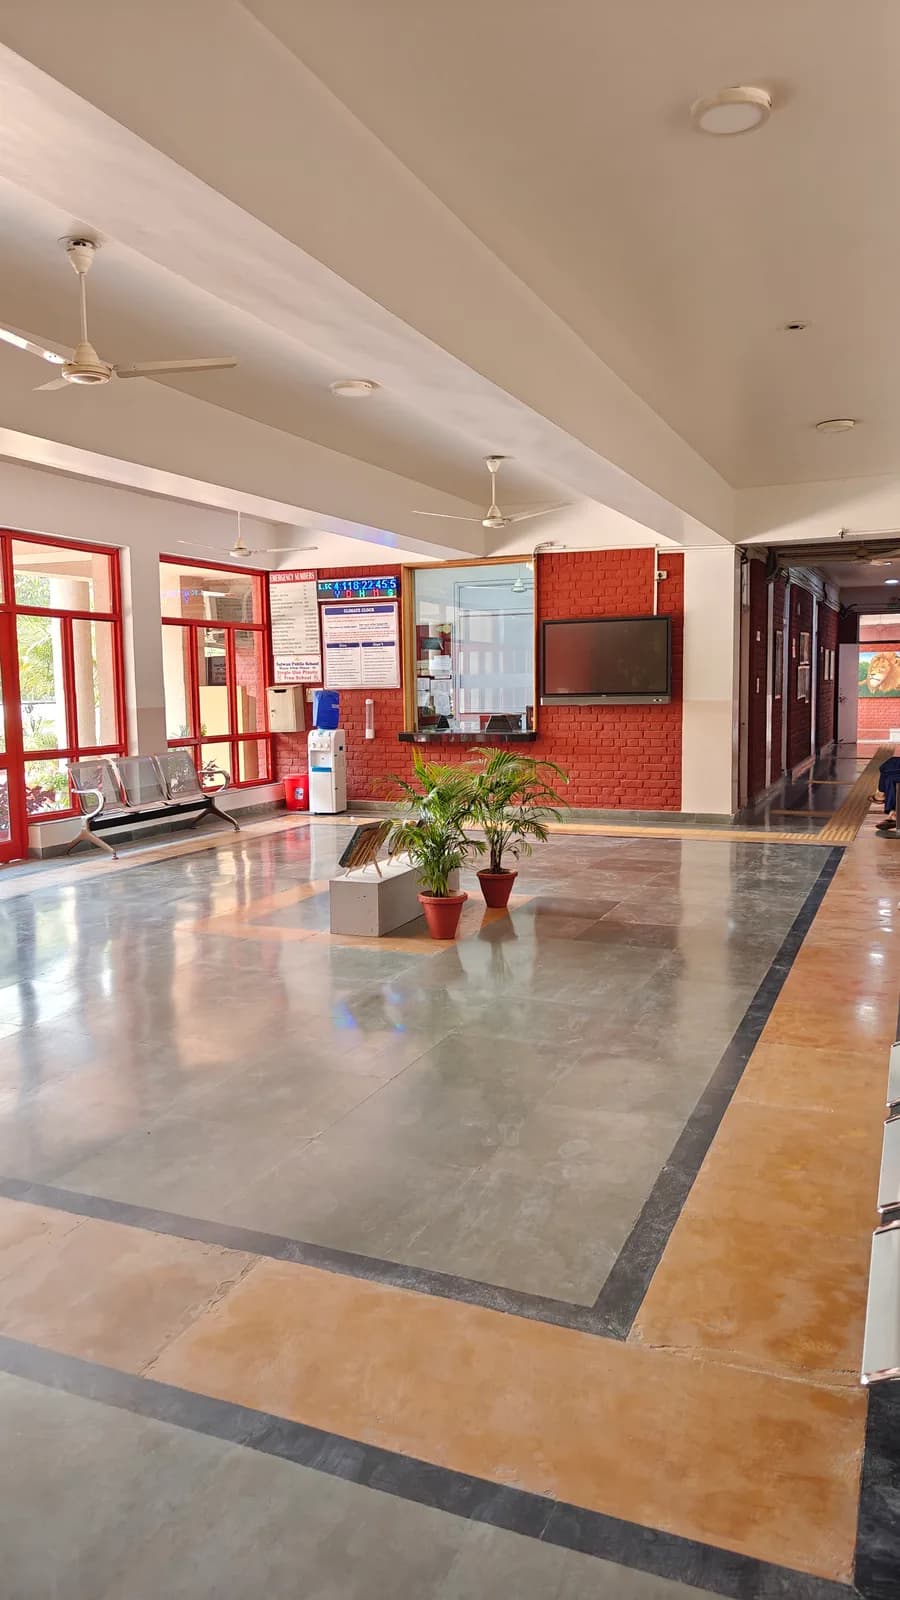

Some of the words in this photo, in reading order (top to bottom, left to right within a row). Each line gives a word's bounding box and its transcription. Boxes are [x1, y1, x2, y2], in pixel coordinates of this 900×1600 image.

[270, 574, 293, 583] EMERGENCY
[294, 572, 315, 581] NUMBERS
[334, 590, 341, 598] Y
[359, 589, 365, 598] H
